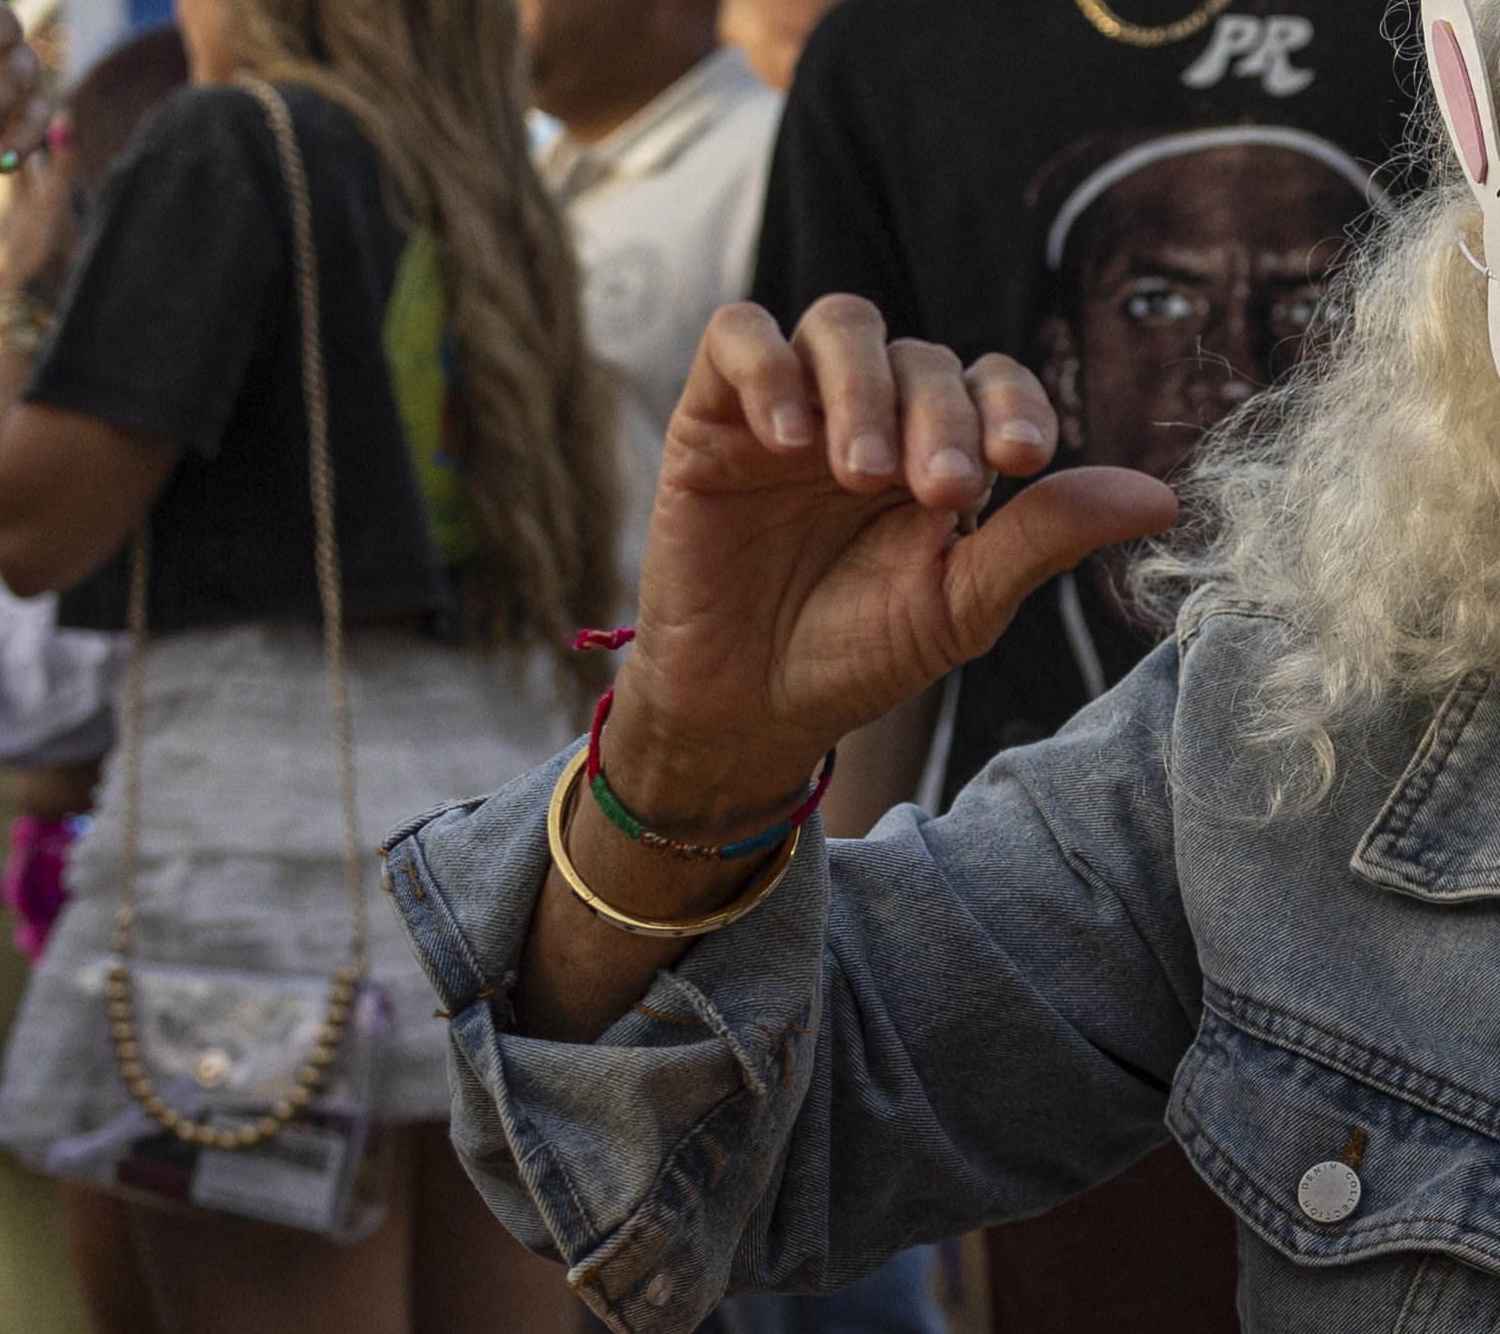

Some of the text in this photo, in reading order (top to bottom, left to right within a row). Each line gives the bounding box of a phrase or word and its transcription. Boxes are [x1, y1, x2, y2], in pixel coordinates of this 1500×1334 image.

[1182, 13, 1316, 98] PR
[1301, 1163, 1357, 1220] DENIM COLLECTION
